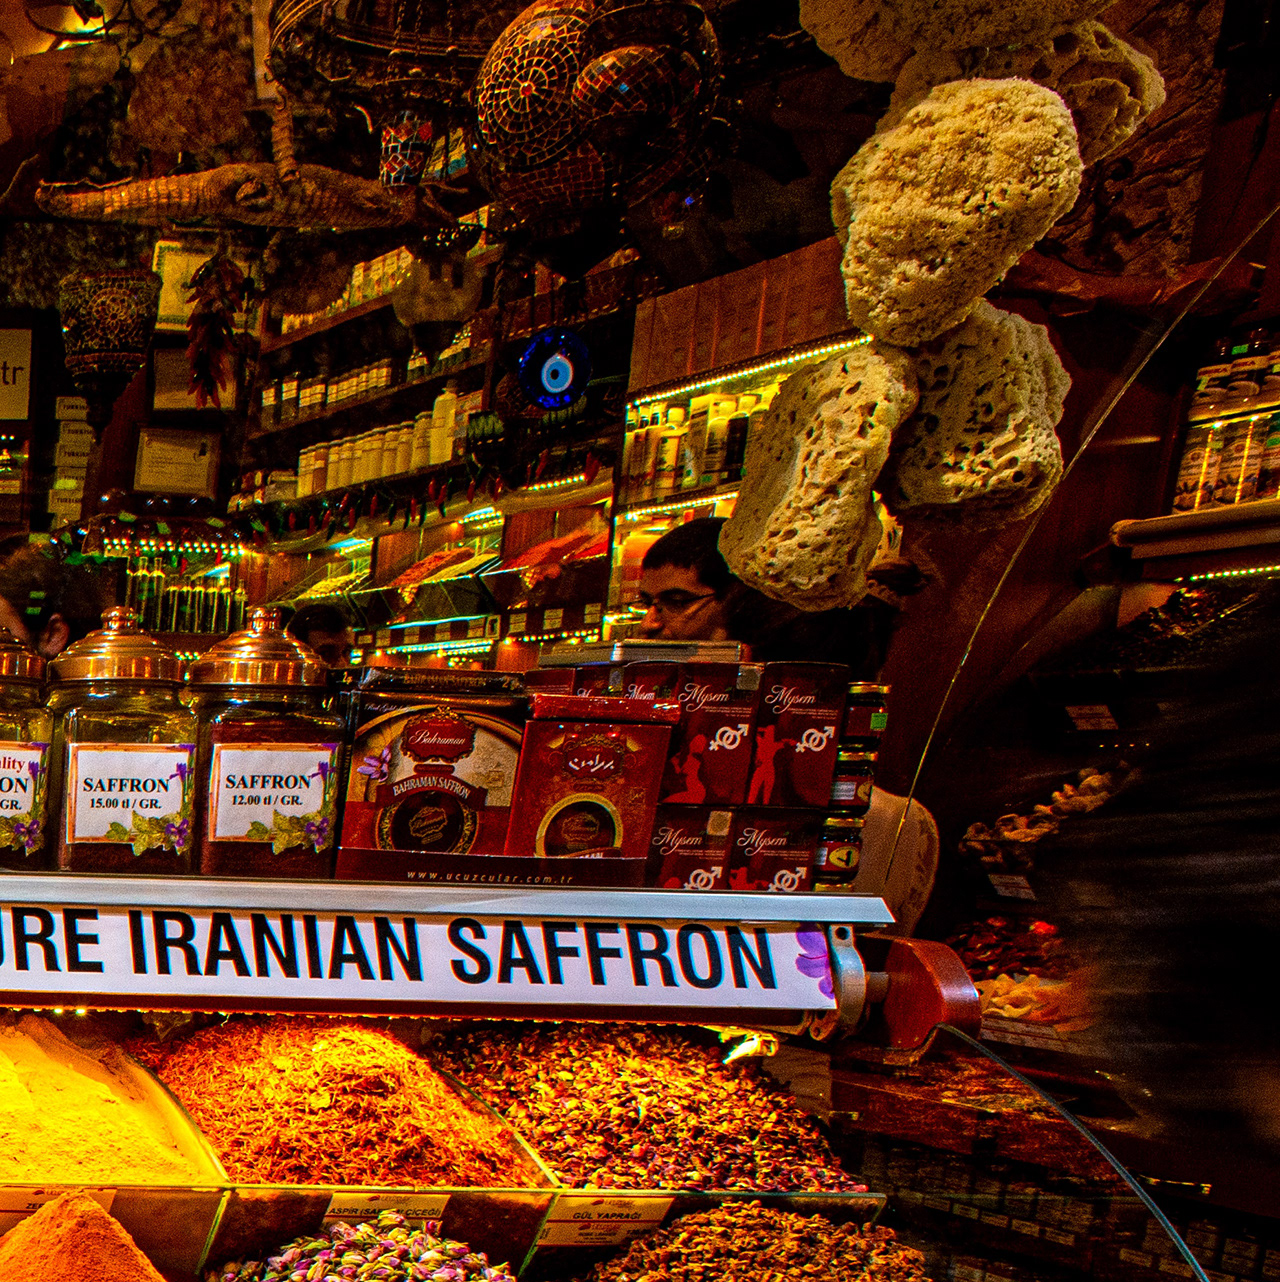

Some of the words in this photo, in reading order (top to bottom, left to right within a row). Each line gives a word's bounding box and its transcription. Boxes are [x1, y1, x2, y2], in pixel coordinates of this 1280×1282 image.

[679, 684, 728, 706] Mysem
[766, 685, 814, 707] Mysem
[409, 731, 465, 748] Bahraman
[393, 778, 438, 798] BAHRAMAN
[439, 776, 470, 798] SAFFRON
[90, 799, 118, 808] 15.00
[140, 799, 161, 808] GR.
[654, 828, 702, 851] Mysem
[408, 870, 574, 885] www.ucuzcular.com.tr
[130, 911, 425, 981] IRANIAN
[449, 917, 777, 991] SAFFRON
[572, 1211, 595, 1220] GÜL
